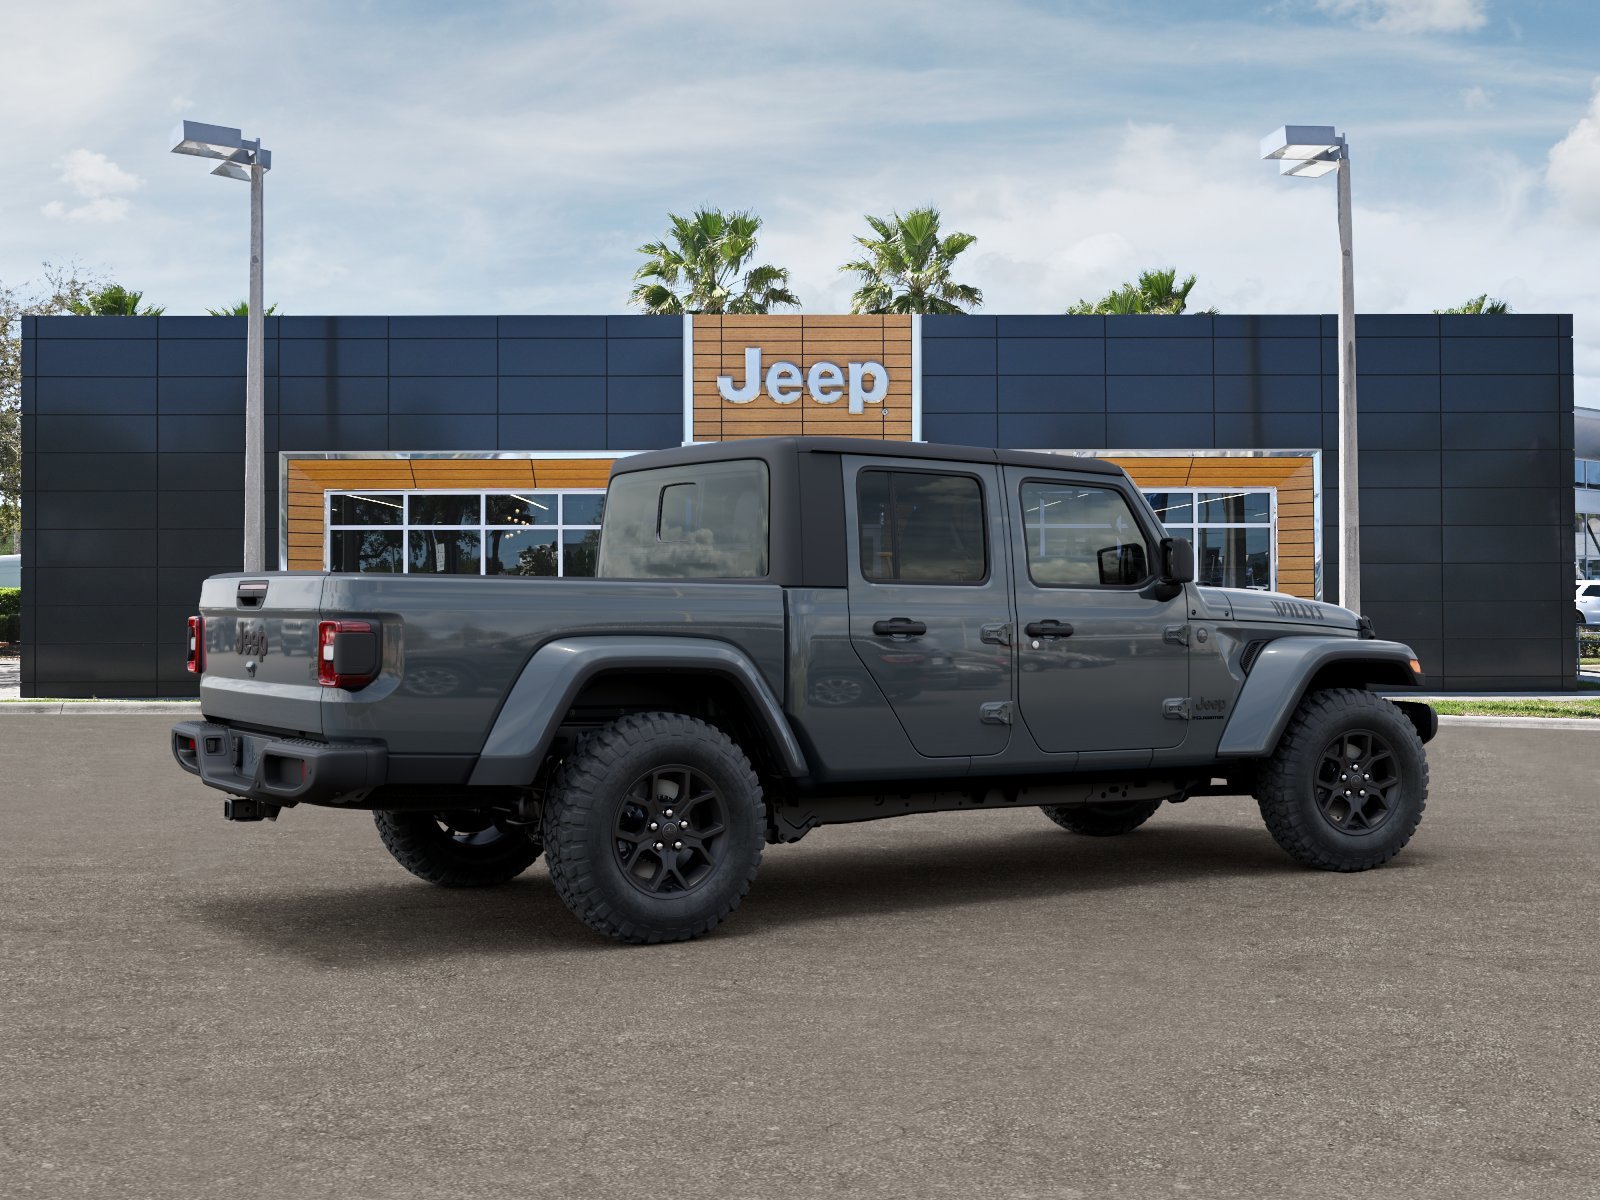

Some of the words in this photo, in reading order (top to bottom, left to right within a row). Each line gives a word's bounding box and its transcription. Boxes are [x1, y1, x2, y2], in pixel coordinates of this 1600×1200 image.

[716, 346, 890, 415] Jeep
[1270, 600, 1324, 620] WILLYS
[235, 621, 269, 663] Jeep
[1195, 695, 1226, 712] Jeep
